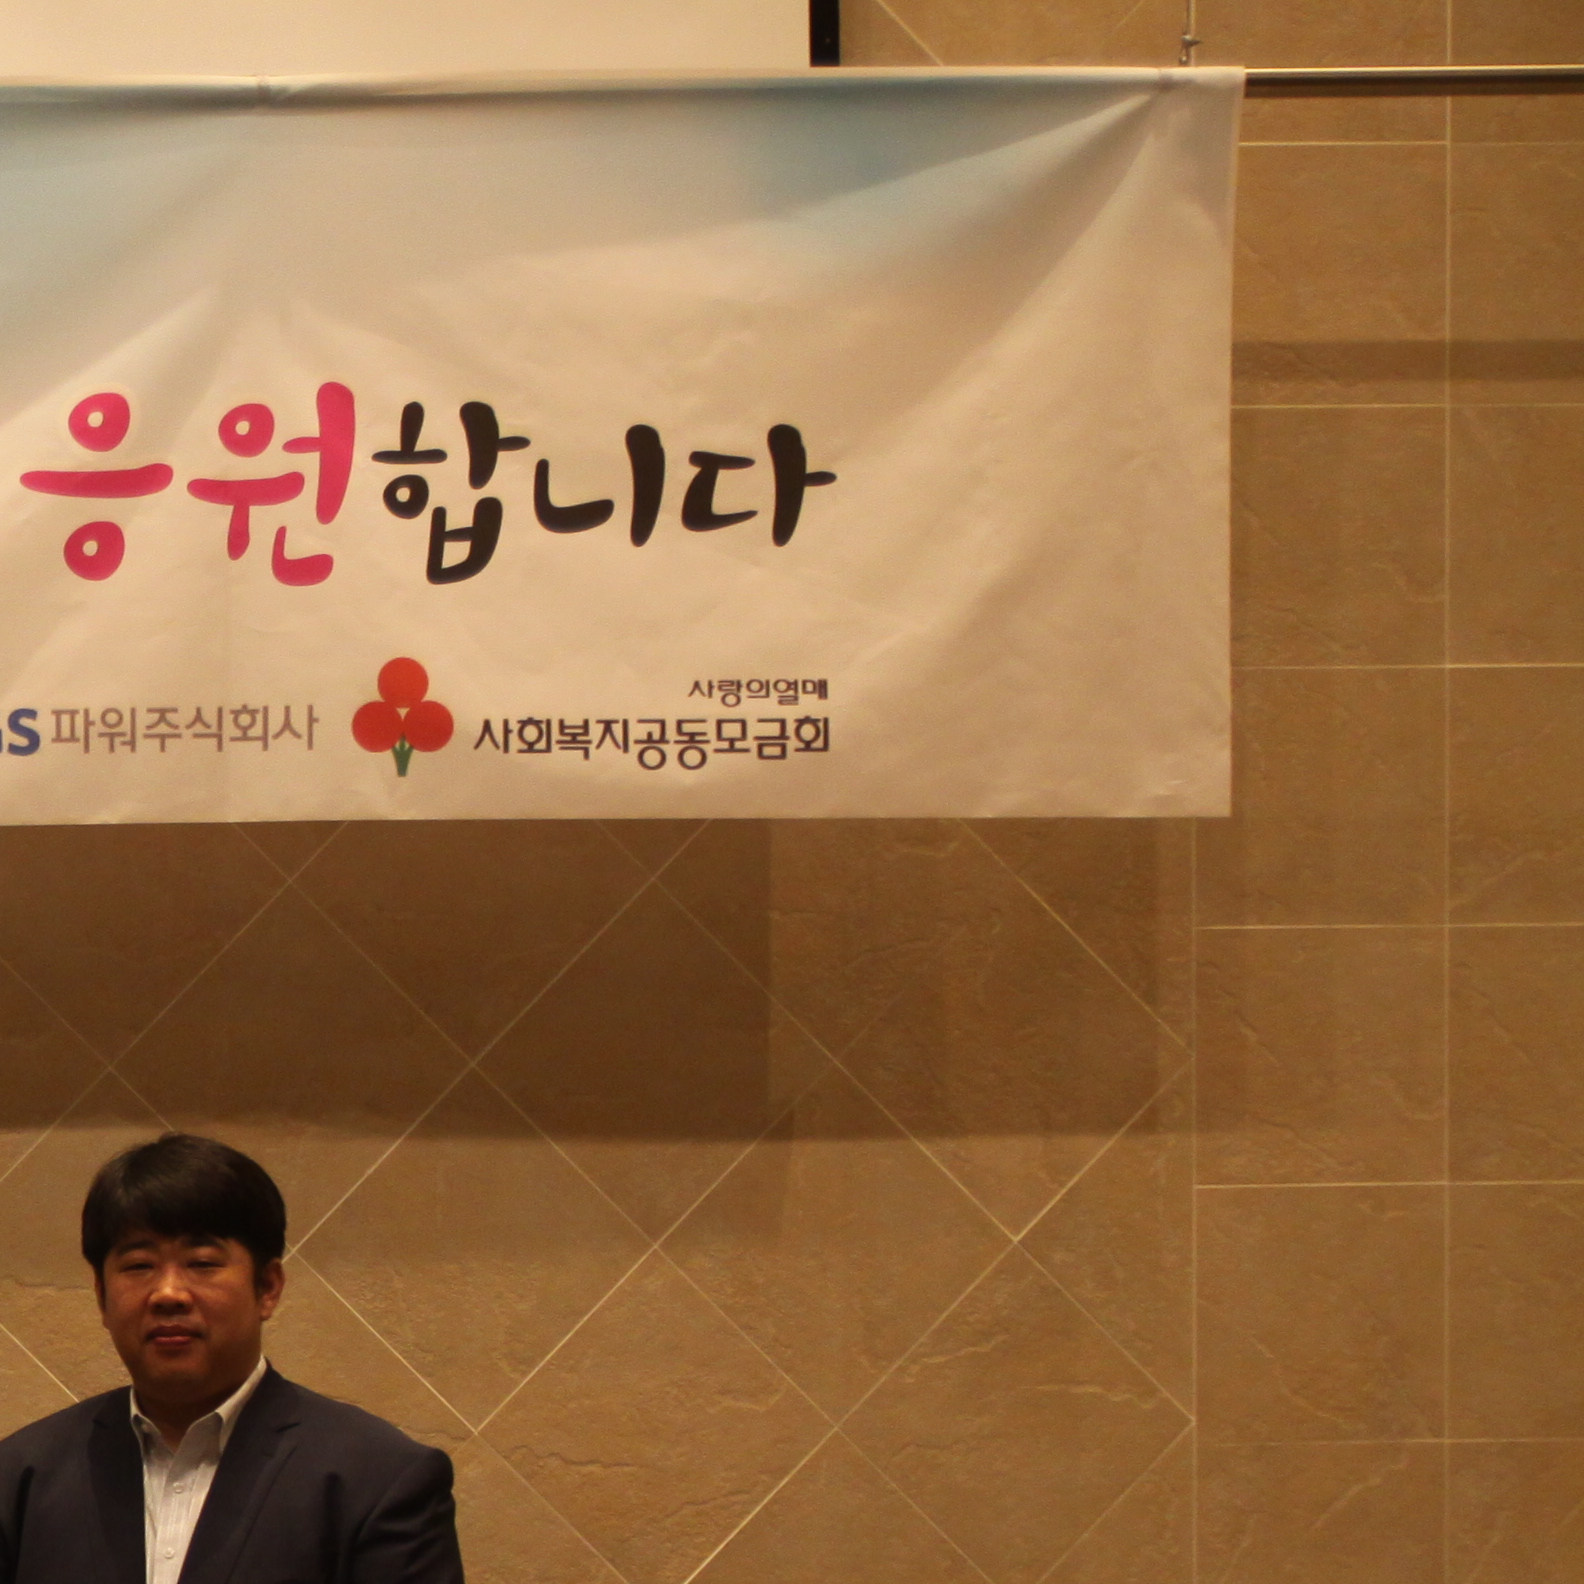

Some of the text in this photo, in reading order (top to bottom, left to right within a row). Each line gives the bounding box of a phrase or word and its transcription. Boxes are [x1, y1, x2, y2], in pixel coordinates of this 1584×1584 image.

[19, 381, 837, 587] 응원합니다
[688, 678, 829, 708] 사랑의열매
[473, 715, 831, 771] 사회복지공동모금회
